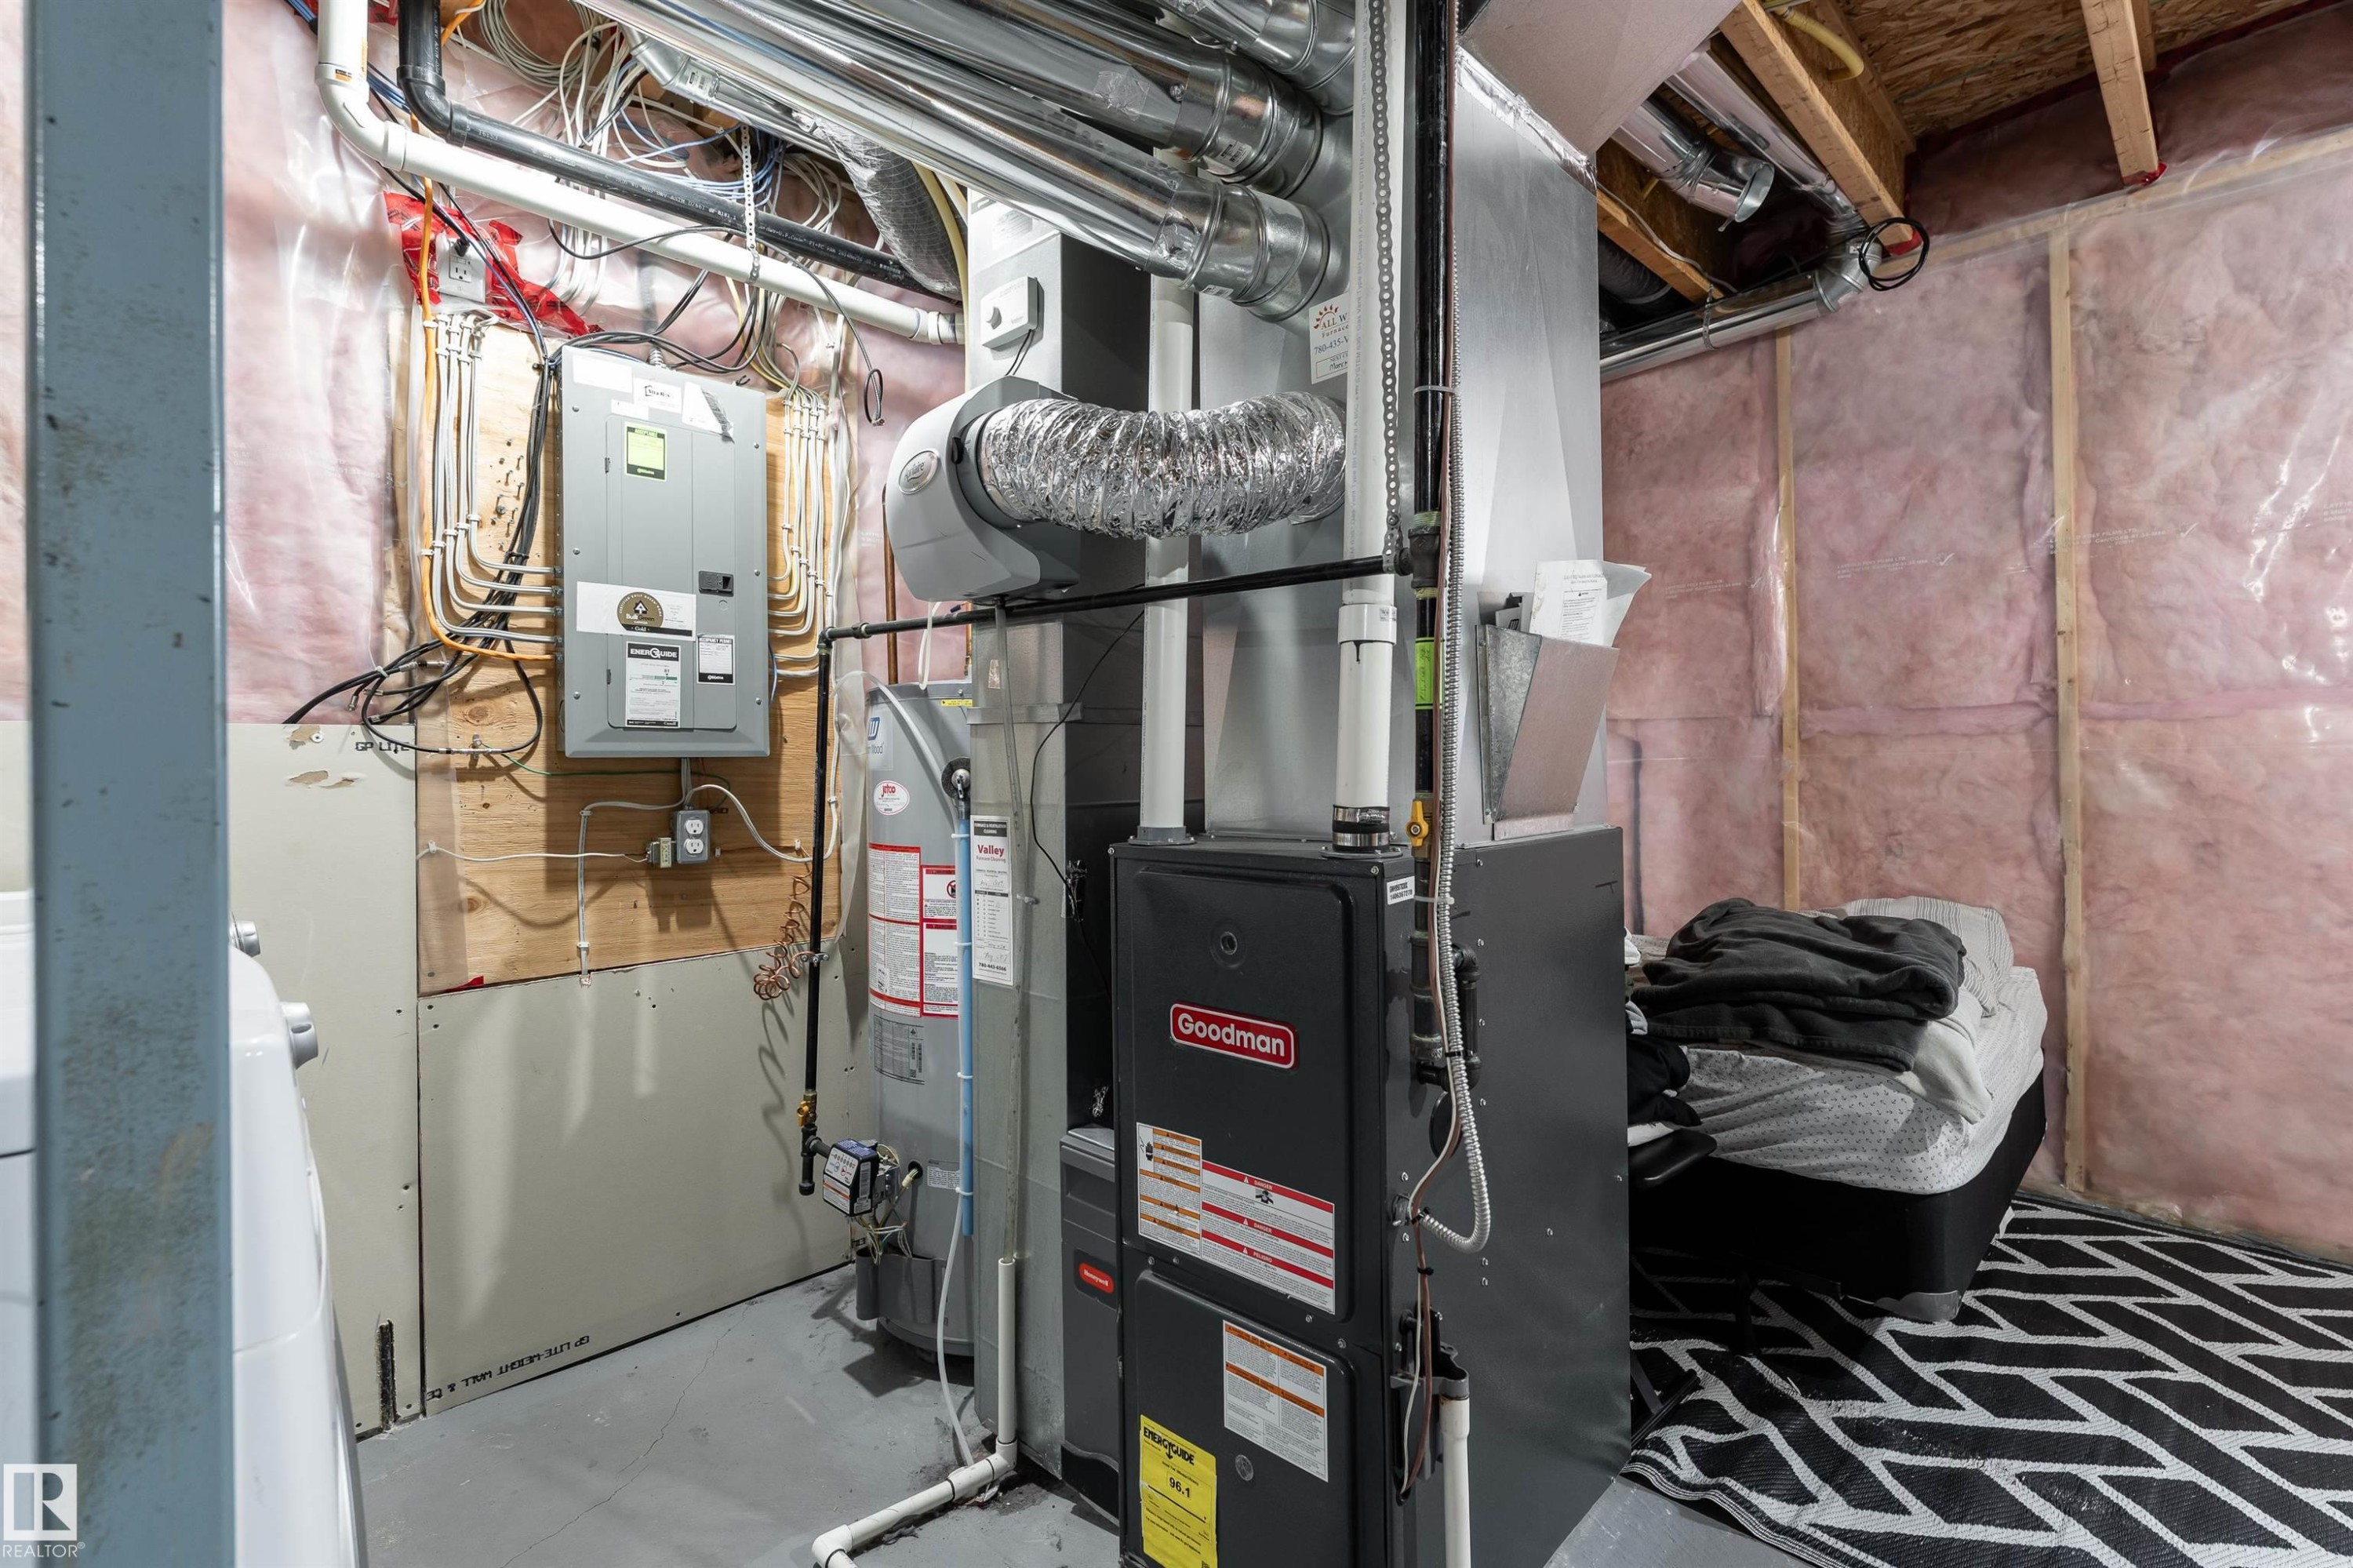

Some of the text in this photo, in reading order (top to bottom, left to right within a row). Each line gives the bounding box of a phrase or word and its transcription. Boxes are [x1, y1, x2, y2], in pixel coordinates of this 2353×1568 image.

[1322, 318, 1337, 329] ALL
[1322, 324, 1349, 338] Furnace
[630, 648, 678, 659] ENERGUIDE
[355, 742, 373, 751] GP
[977, 845, 1004, 857] Valley
[1178, 1013, 1285, 1057] Goodman
[1254, 1180, 1273, 1191] DANGER
[1253, 1222, 1272, 1234] DANGER
[1253, 1252, 1272, 1263] PELIGRO
[1084, 1269, 1109, 1286] Honeywell
[575, 1335, 590, 1348] GP
[497, 1342, 570, 1375] LITE-WEIGHT
[461, 1370, 492, 1387] WALL
[447, 1384, 456, 1392] &
[1144, 1427, 1195, 1466] ENERGYGUIDE
[1169, 1477, 1191, 1498] 96.1
